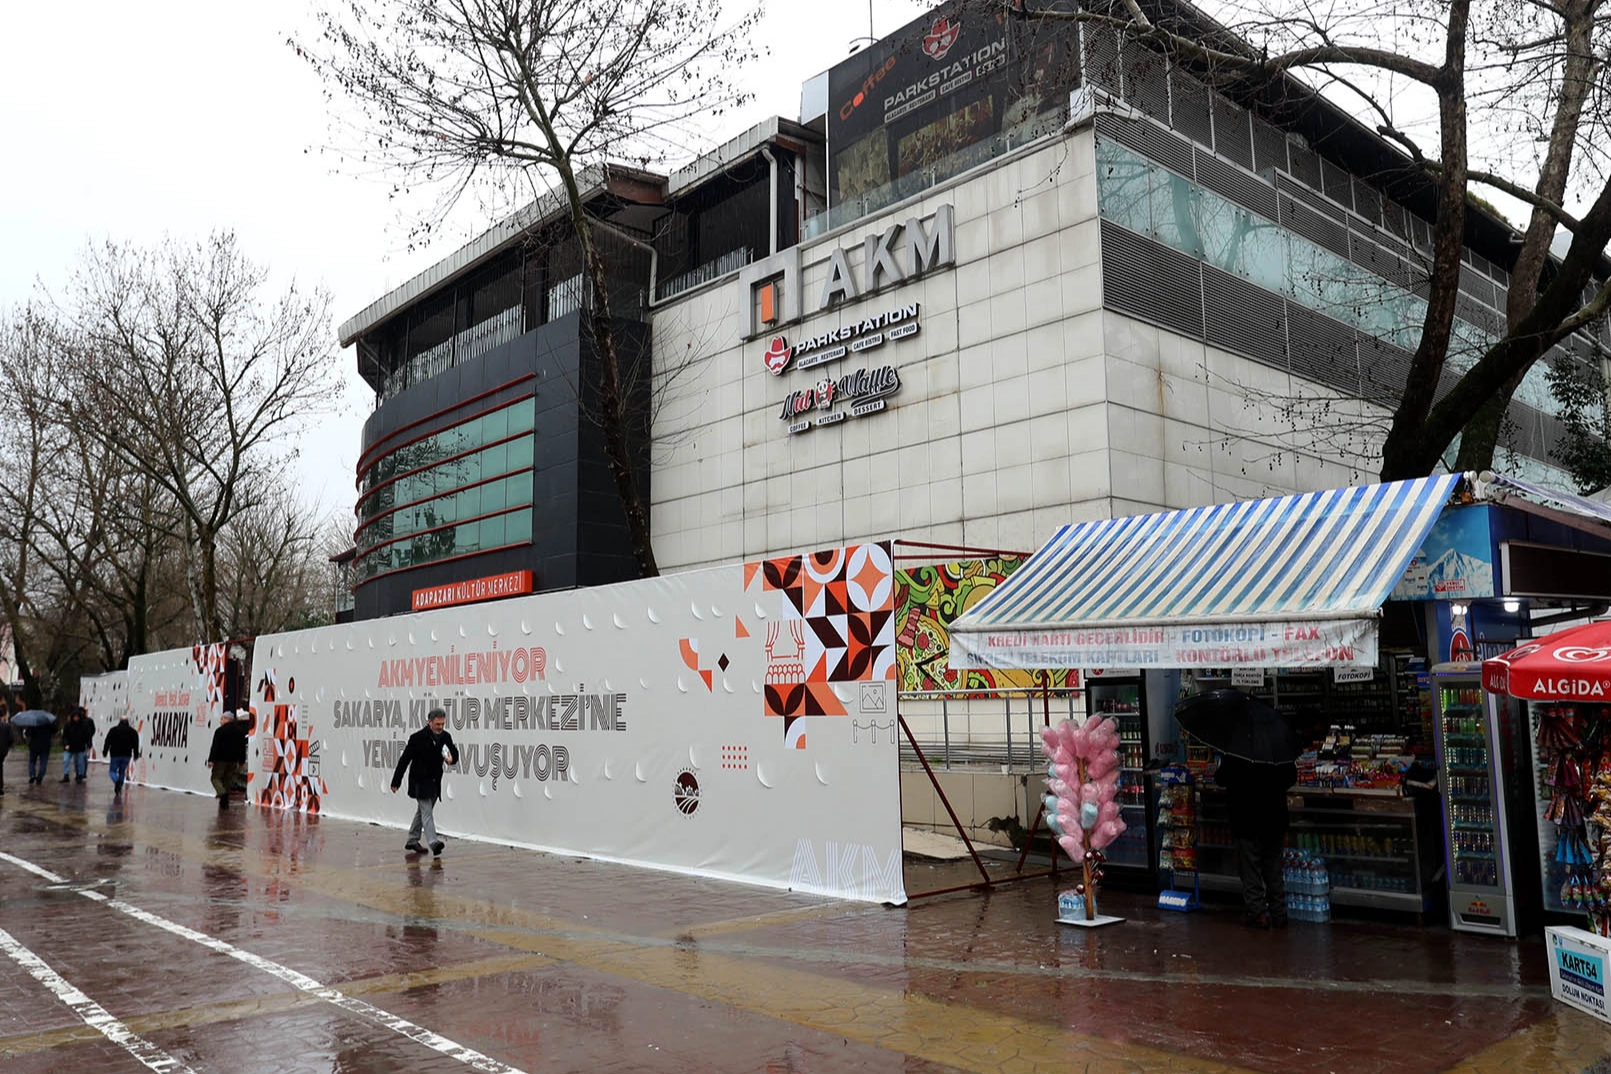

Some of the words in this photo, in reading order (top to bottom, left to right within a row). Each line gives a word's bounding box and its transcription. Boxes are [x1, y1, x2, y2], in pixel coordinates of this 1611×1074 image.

[840, 55, 897, 121] Coffee
[883, 37, 1006, 112] PARKSTATION
[820, 203, 955, 310] AKM
[795, 302, 920, 355] PARKSTATION
[902, 324, 915, 334] FOOD
[853, 342, 865, 351] CAFE
[839, 366, 896, 397] Waffle
[853, 402, 882, 416] DESSERT
[789, 422, 807, 433] COFFEE
[415, 586, 455, 607] ADAPAZARI
[456, 579, 486, 600] KÜLTÜR
[988, 632, 1027, 648] KREDİ
[1031, 632, 1071, 646] KARTI
[1181, 625, 1265, 643] FOTOKOPİ
[1284, 626, 1320, 641] FAX
[151, 711, 188, 748] SAKARYA
[788, 837, 903, 900] AKM
[1561, 952, 1597, 979] KART54
